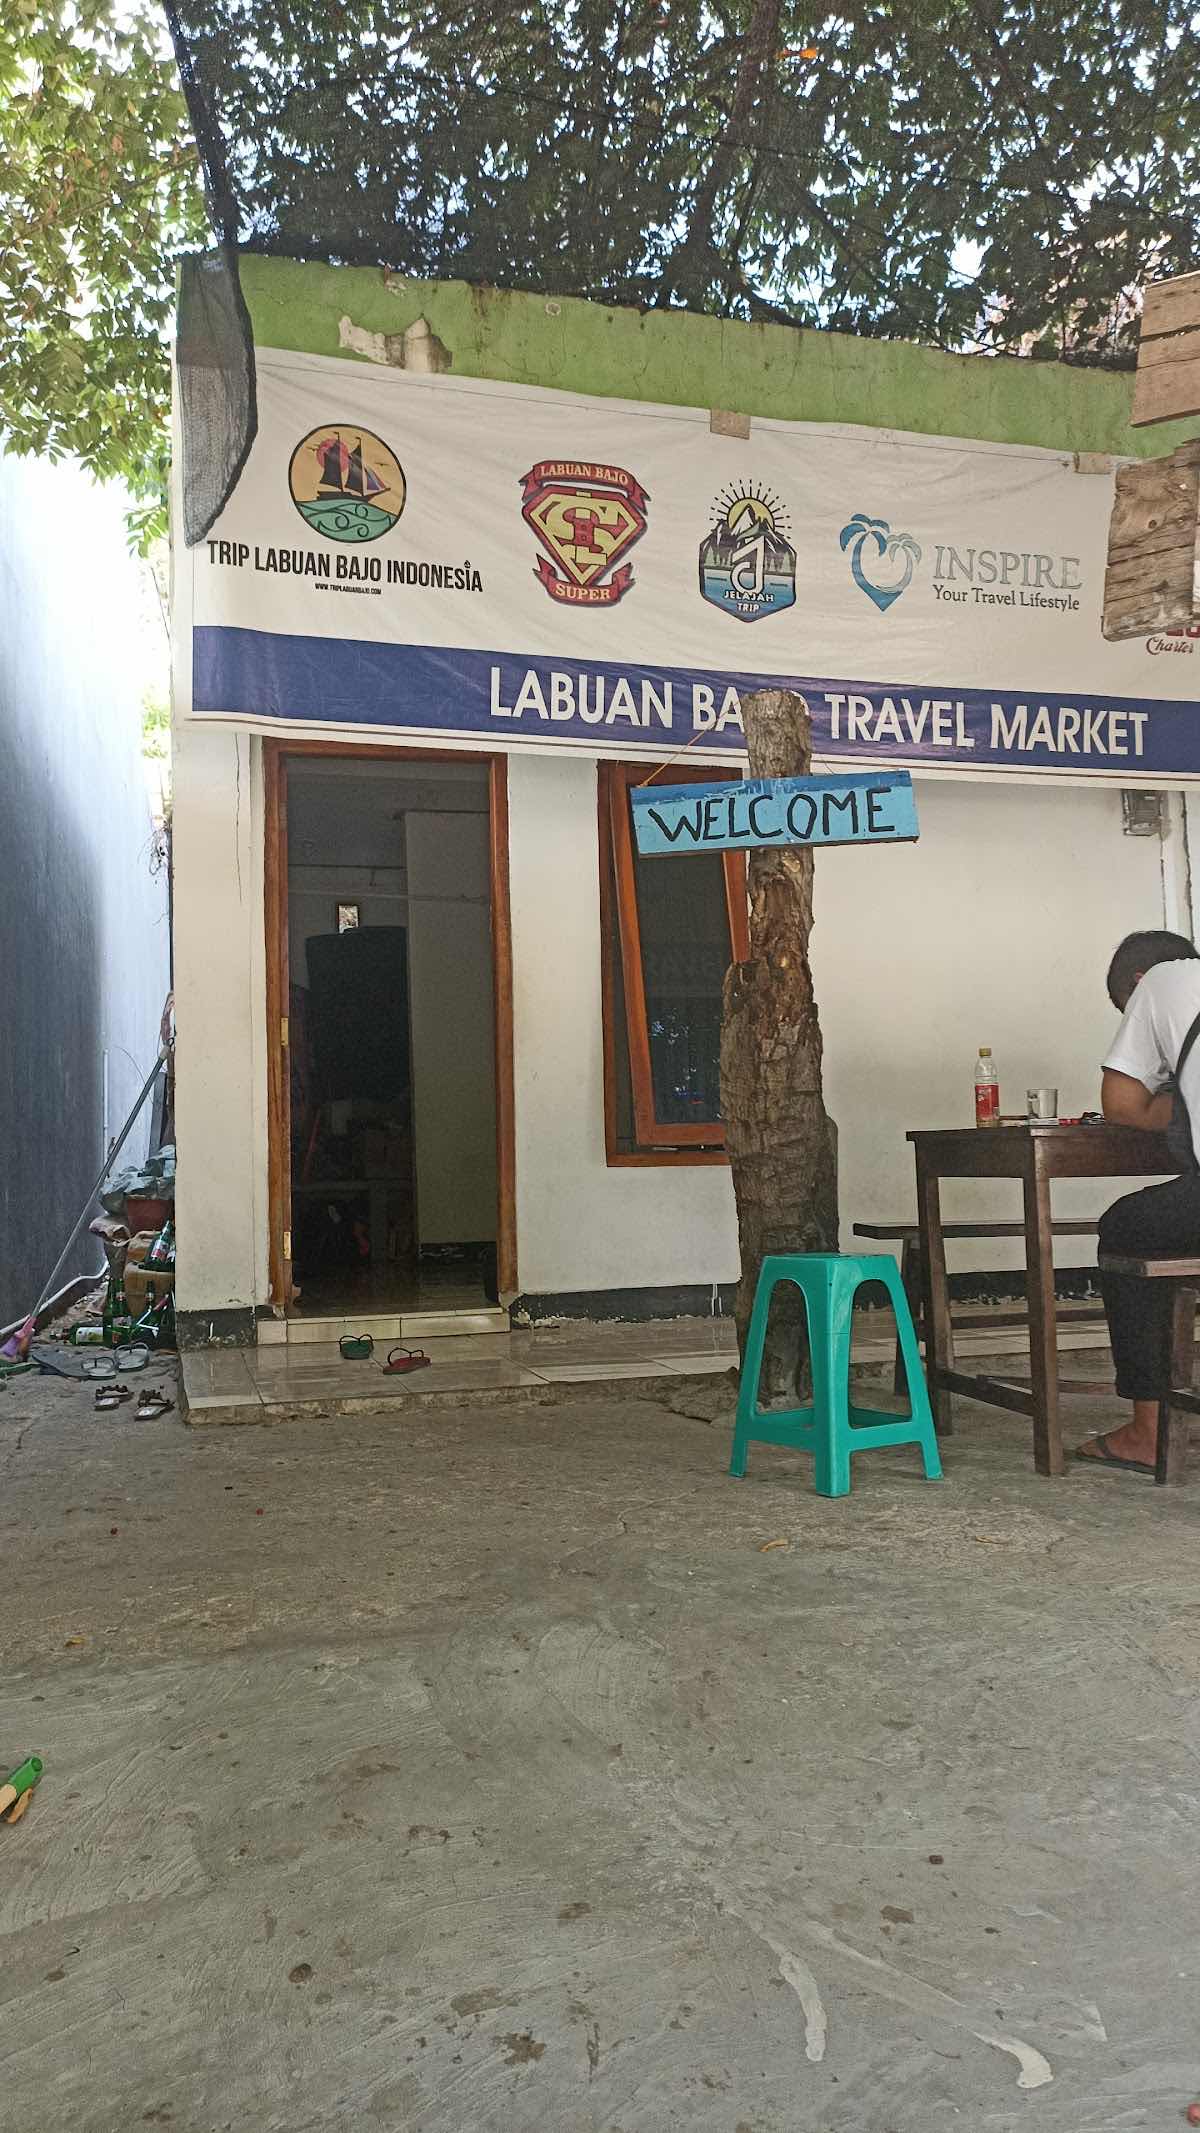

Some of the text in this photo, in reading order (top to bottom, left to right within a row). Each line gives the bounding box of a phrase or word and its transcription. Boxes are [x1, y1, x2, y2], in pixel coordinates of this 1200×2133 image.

[540, 464, 629, 485] LABUAN BAJO
[207, 540, 484, 592] TRIP LABUAN BAJO INDONESIA
[932, 545, 1083, 590] INSPIRE
[555, 583, 611, 600] SUPER
[723, 590, 775, 602] JELAJAH
[932, 584, 1080, 612] Your Travel Lifestyle
[736, 602, 760, 612] TRIP
[490, 667, 673, 728] LABUAN
[824, 693, 976, 748] TRAVEL
[990, 703, 1149, 756] MARKET
[647, 786, 896, 842] WELCOME
